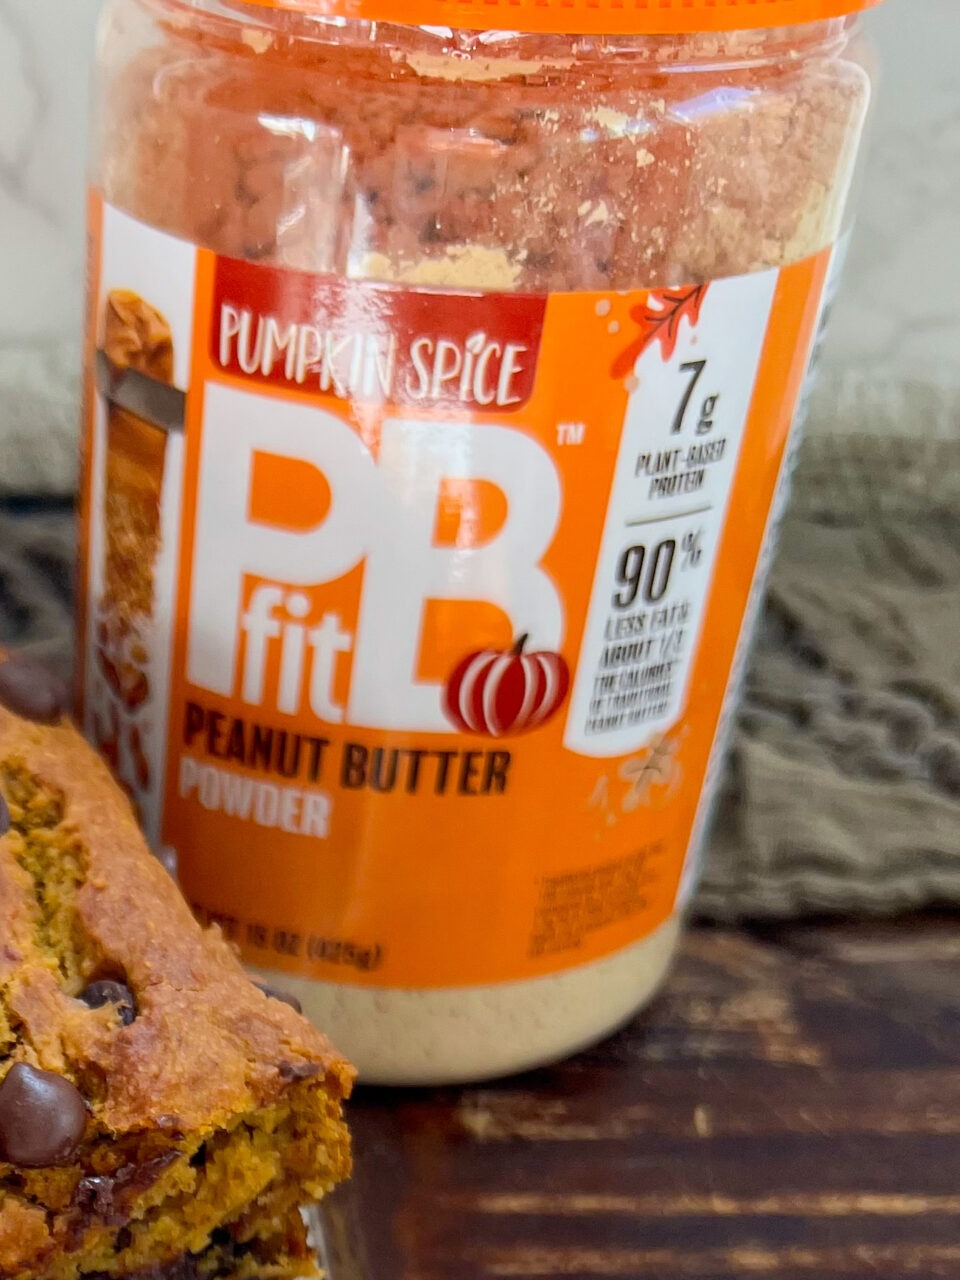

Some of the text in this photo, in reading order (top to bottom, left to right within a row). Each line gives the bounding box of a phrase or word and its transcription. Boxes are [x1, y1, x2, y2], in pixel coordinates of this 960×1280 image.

[219, 304, 528, 406] PUMPKIN SPICE
[670, 359, 720, 436] 7g
[634, 438, 727, 478] PLANT-BASED
[648, 468, 707, 501] PROTEIN
[185, 380, 567, 735] PB
[242, 583, 352, 724] fit
[183, 701, 512, 796] PEANUT BUTTER
[179, 756, 333, 840] POWDER
